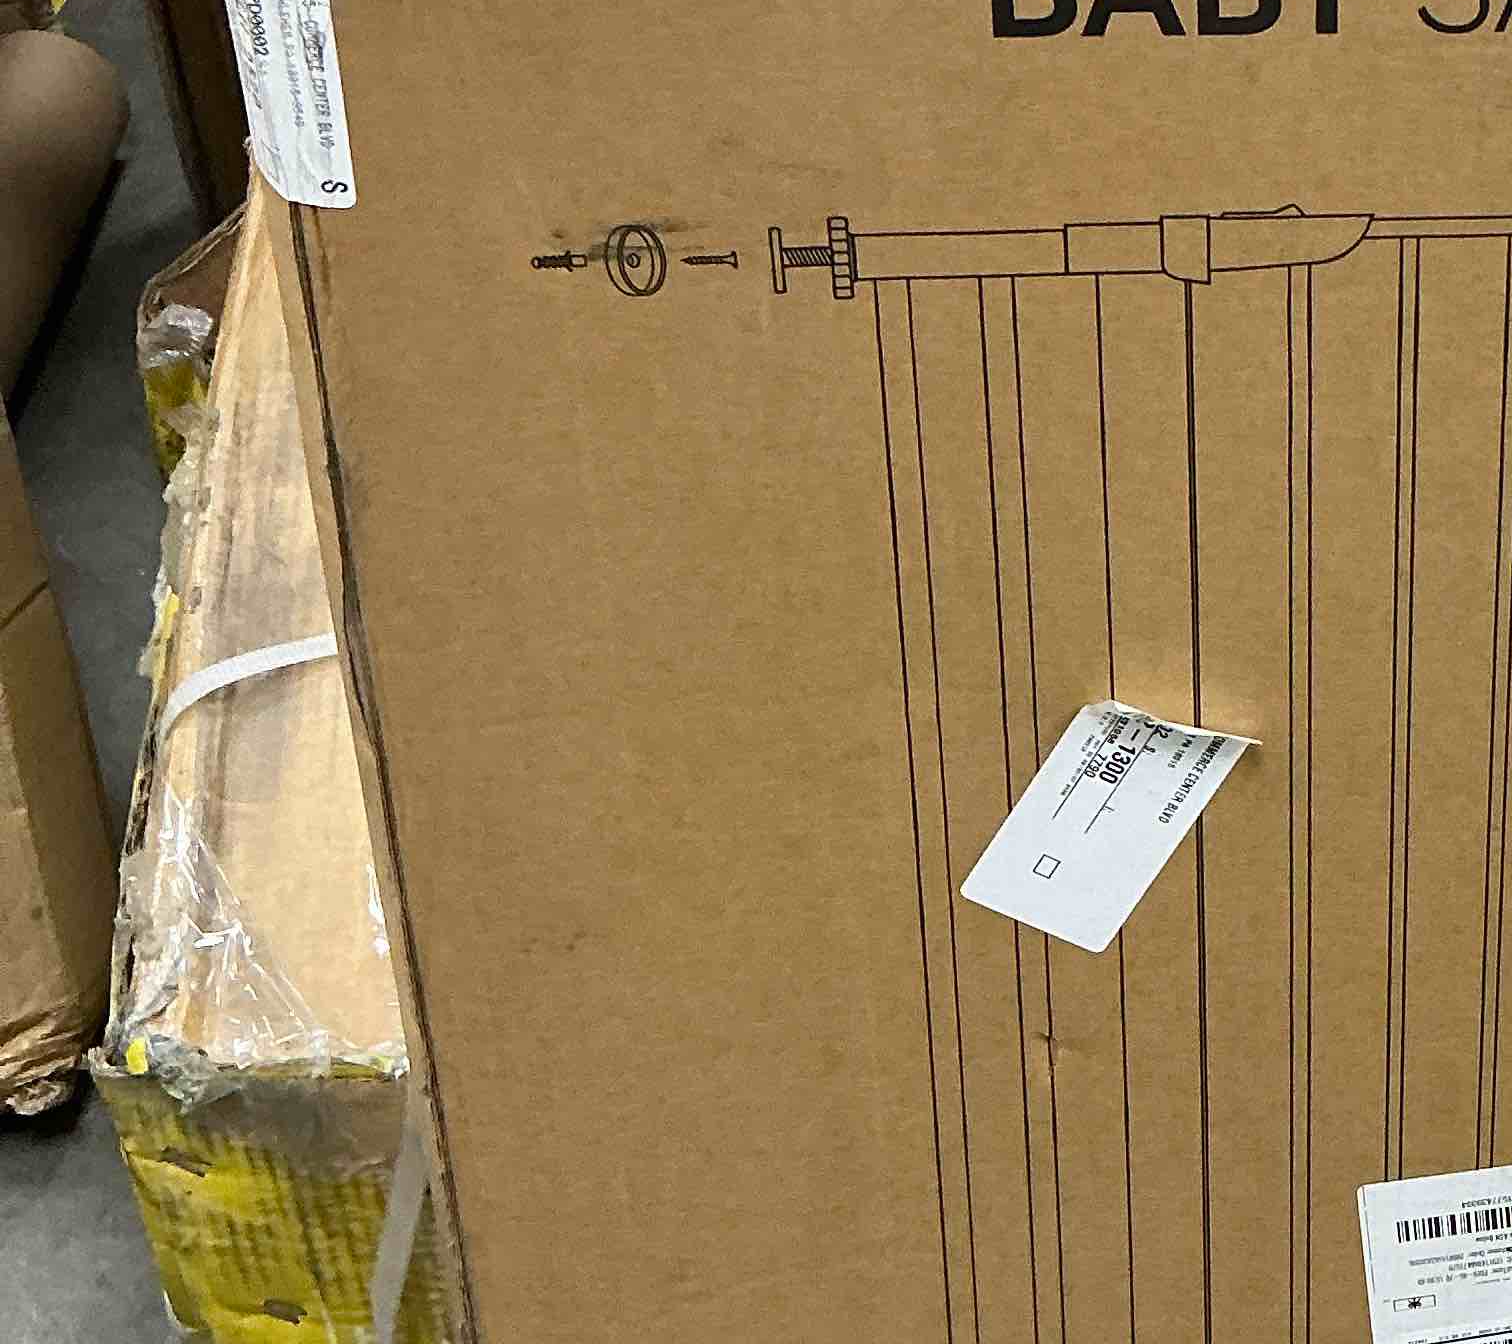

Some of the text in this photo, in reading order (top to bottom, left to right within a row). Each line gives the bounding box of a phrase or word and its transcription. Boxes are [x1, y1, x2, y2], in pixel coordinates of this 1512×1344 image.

[312, 77, 331, 118] CENTER
[321, 178, 349, 194] S
[1170, 770, 1200, 805] CENTER
[1156, 800, 1177, 824] BLVD
